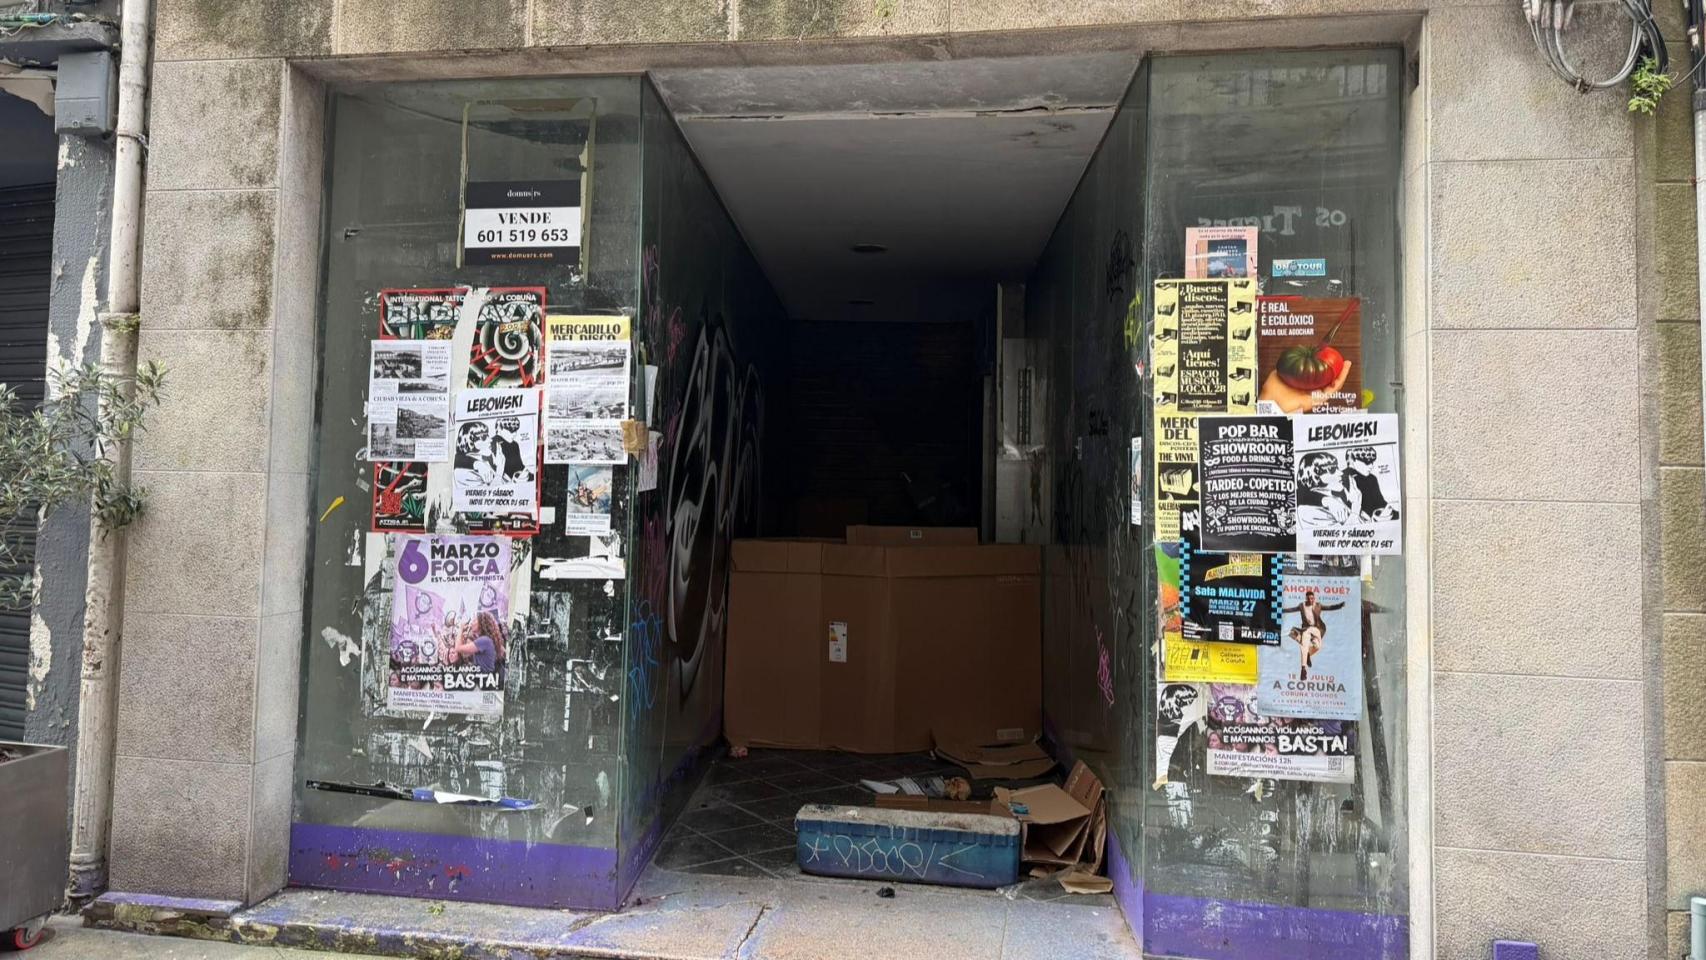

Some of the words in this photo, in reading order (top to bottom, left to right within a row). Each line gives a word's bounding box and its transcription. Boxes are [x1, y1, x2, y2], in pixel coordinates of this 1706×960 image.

[499, 212, 551, 224] VENDE
[478, 230, 503, 242] 601
[509, 229, 536, 242] 519
[541, 229, 568, 241] 653
[505, 292, 536, 301] CORUÑA
[1268, 302, 1289, 312] REAL
[1268, 313, 1314, 325] ECOLÓXICO
[550, 323, 621, 334] MERCADILLO
[1180, 369, 1219, 378] ESPACIO
[1180, 377, 1221, 385] MUSICAL
[467, 394, 524, 413] LEBOWSKI
[1160, 417, 1197, 429] MERC
[1164, 429, 1192, 440] DEL
[1218, 425, 1247, 439] POP
[1249, 424, 1279, 439] BAR
[1308, 420, 1378, 442] LEBOWSKI
[1212, 443, 1286, 455] SHOWROOM
[1159, 452, 1173, 461] THE
[1174, 452, 1196, 461] VINYL
[1221, 455, 1241, 463] FOOD
[1248, 455, 1276, 463] DRINKS
[1205, 478, 1244, 493] TARDEO
[1249, 477, 1295, 493] COPETEO
[1230, 491, 1258, 499] MEJORES
[1258, 492, 1286, 501] MOJITOS
[1246, 498, 1269, 506] CIUDAD
[1250, 525, 1281, 533] ENCUENTRO
[1313, 529, 1340, 537] VIERNES
[1342, 529, 1347, 537] Y
[1347, 527, 1375, 538] SÁBADO
[1318, 539, 1336, 548] INDIE
[1337, 539, 1351, 548] POP
[1371, 540, 1379, 548] DJ
[1380, 539, 1394, 548] SET
[430, 542, 500, 560] MARZO
[397, 539, 429, 584] 6
[430, 559, 500, 576] FOLGA
[1195, 586, 1216, 597] Sala
[1218, 587, 1266, 600] MALAVIDA
[1283, 585, 1320, 593] AHORA
[1324, 585, 1350, 594] QUÉ?
[1242, 600, 1256, 611] 27
[444, 673, 499, 689] BASTA!
[1311, 674, 1335, 682] JULIO
[1273, 680, 1282, 690] A
[1278, 735, 1348, 755] BASTA!
[1214, 752, 1278, 764] MANIFESTACIÓNS
